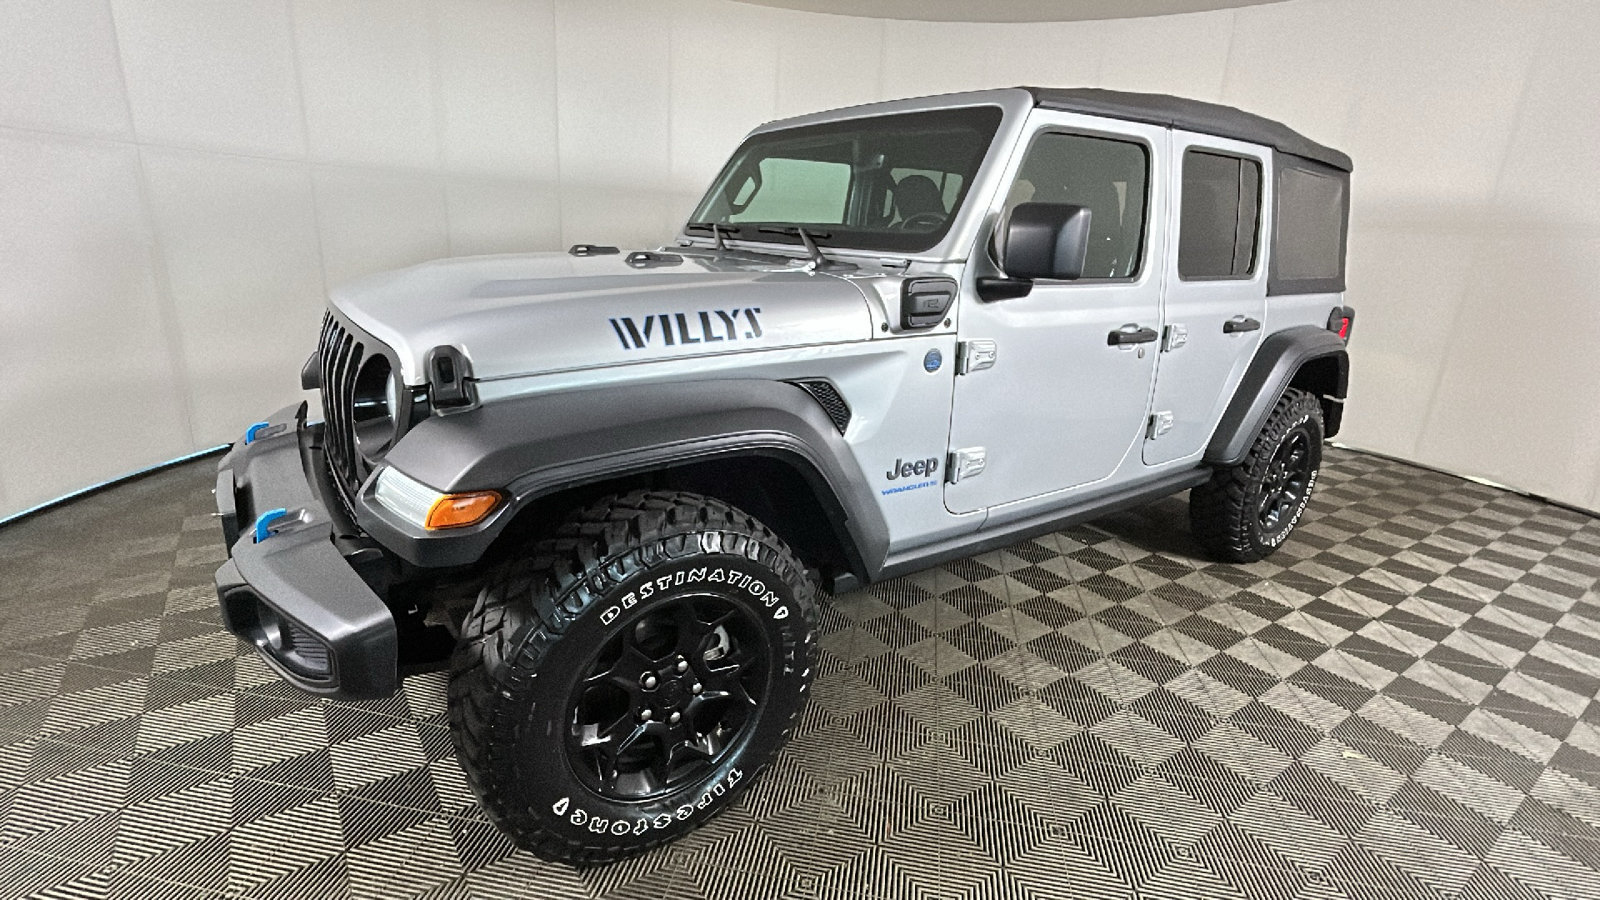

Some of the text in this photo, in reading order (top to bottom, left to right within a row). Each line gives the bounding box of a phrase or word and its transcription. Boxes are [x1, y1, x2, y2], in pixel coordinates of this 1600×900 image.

[609, 308, 763, 349] WILLYS
[887, 457, 938, 480] Jeep
[600, 567, 780, 625] DESTINATION
[570, 768, 743, 836] Firestone
